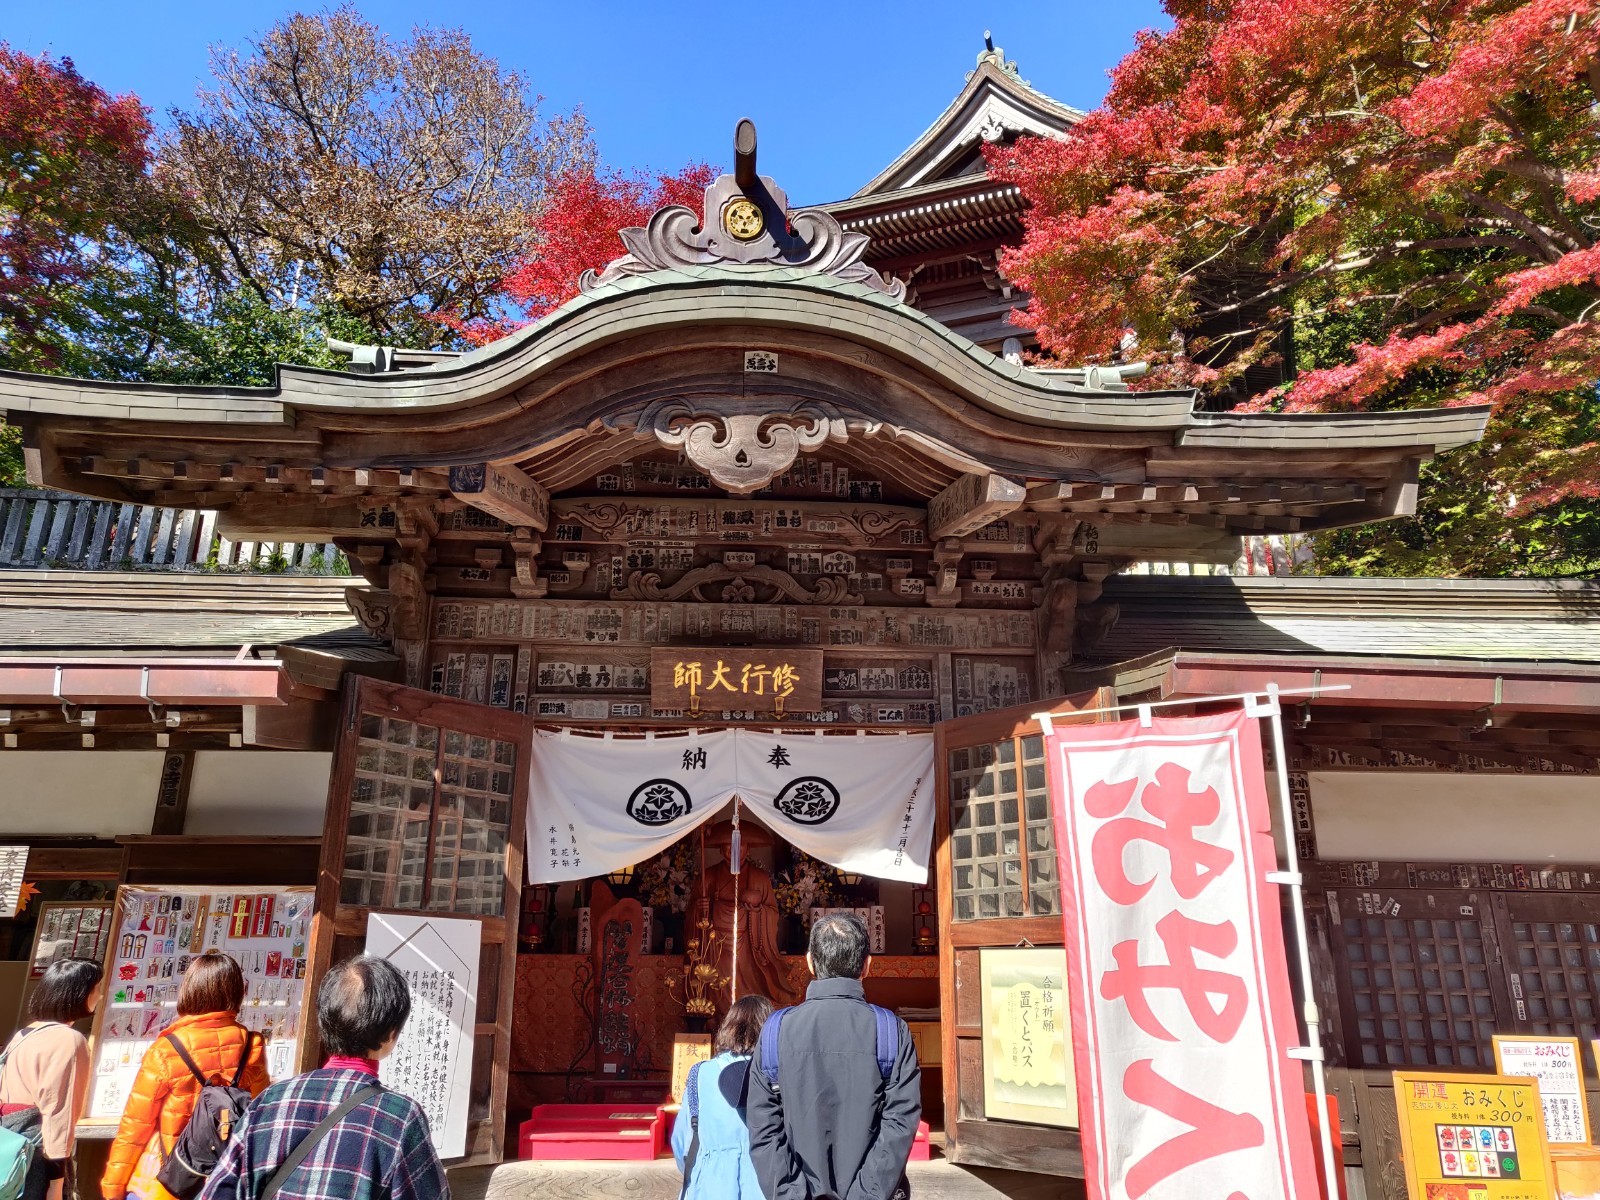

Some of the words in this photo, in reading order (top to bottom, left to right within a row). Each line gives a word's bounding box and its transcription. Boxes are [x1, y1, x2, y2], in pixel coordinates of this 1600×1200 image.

[673, 659, 800, 697] 修行大師
[681, 747, 707, 771] 納
[766, 744, 791, 769] 奉
[1042, 975, 1055, 1033] 合格祈願
[1019, 990, 1033, 1068] 置くとパス
[1534, 1045, 1570, 1058] おみくじ
[1413, 1082, 1449, 1100] 開運
[1462, 1088, 1524, 1108] おみくじ
[1490, 1110, 1522, 1122] 300
